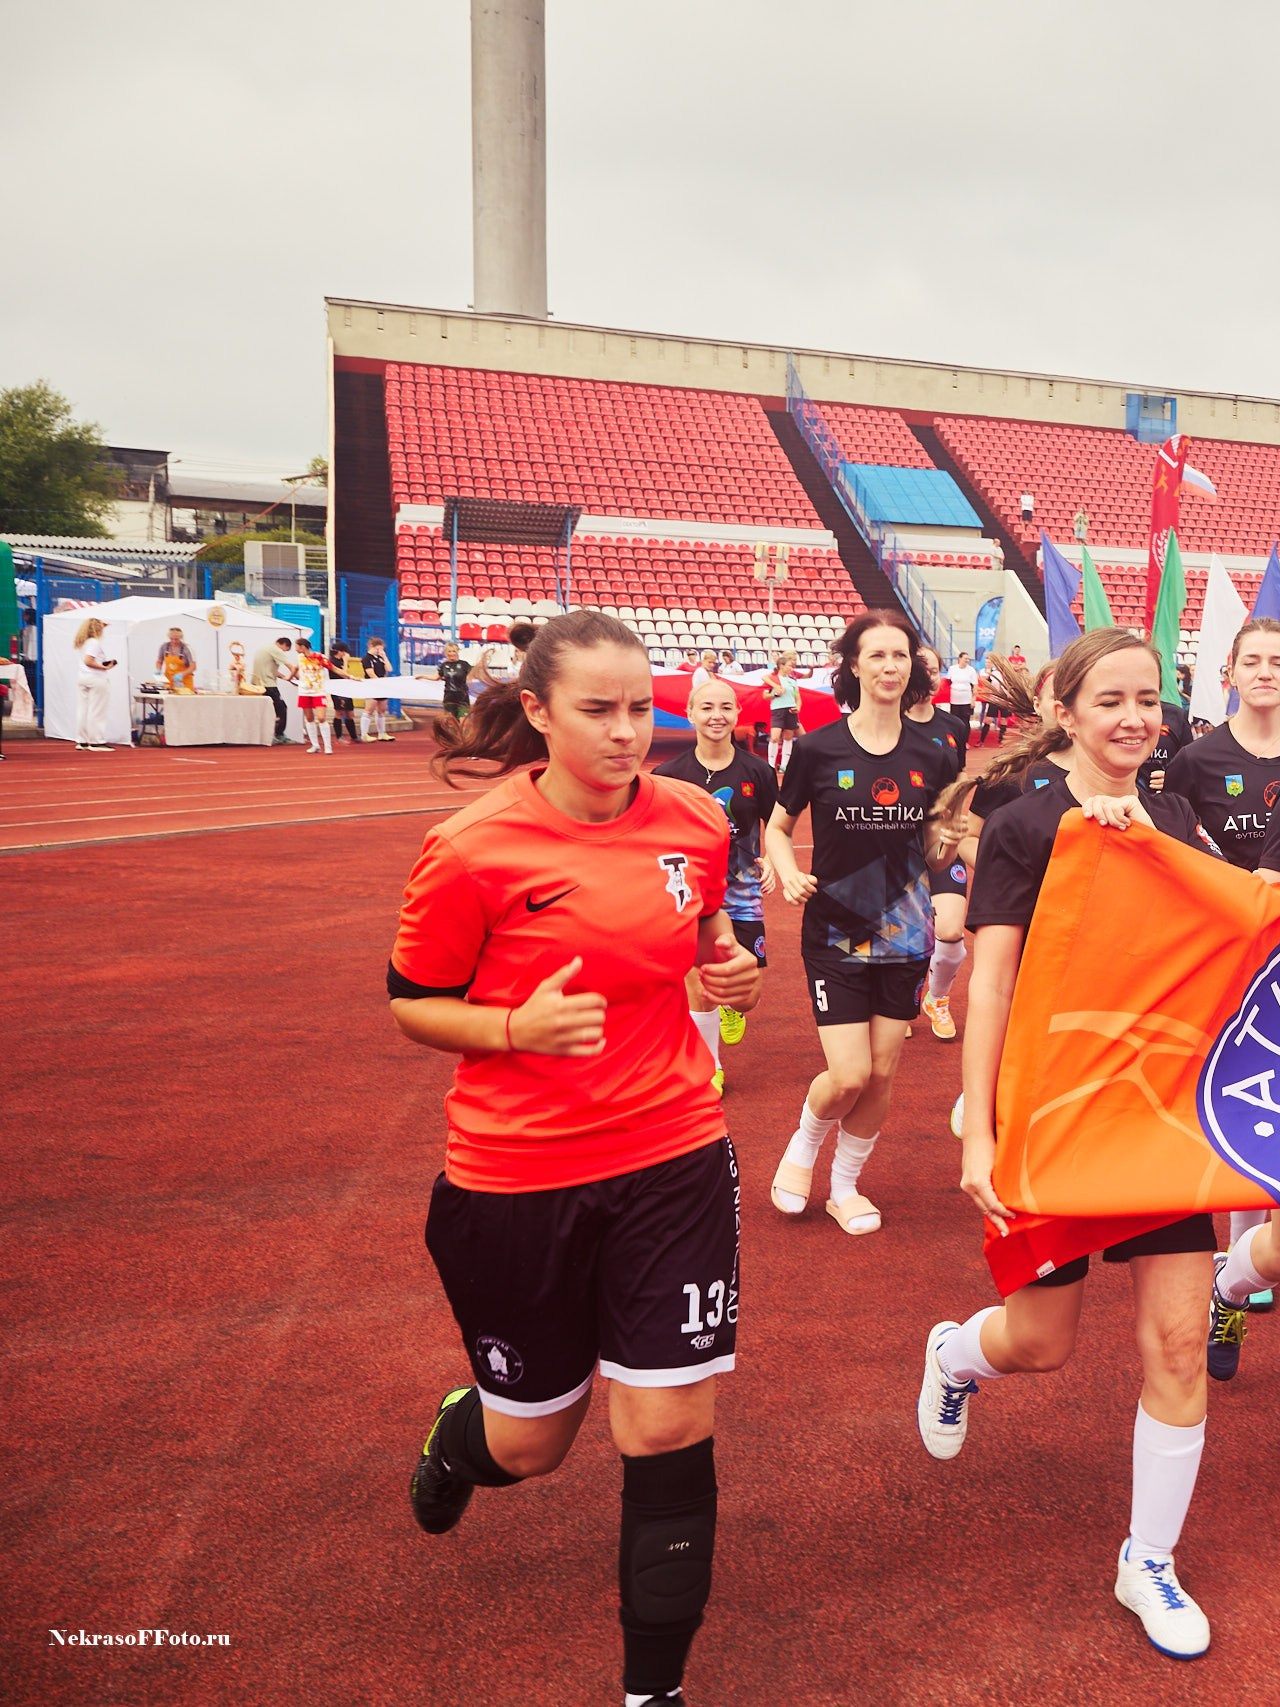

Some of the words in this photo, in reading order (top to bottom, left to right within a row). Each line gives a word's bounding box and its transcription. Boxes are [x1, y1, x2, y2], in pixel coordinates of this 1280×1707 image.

[1235, 830, 1266, 840] ФУТБО
[815, 979, 829, 1012] 5
[681, 1279, 725, 1333] 13
